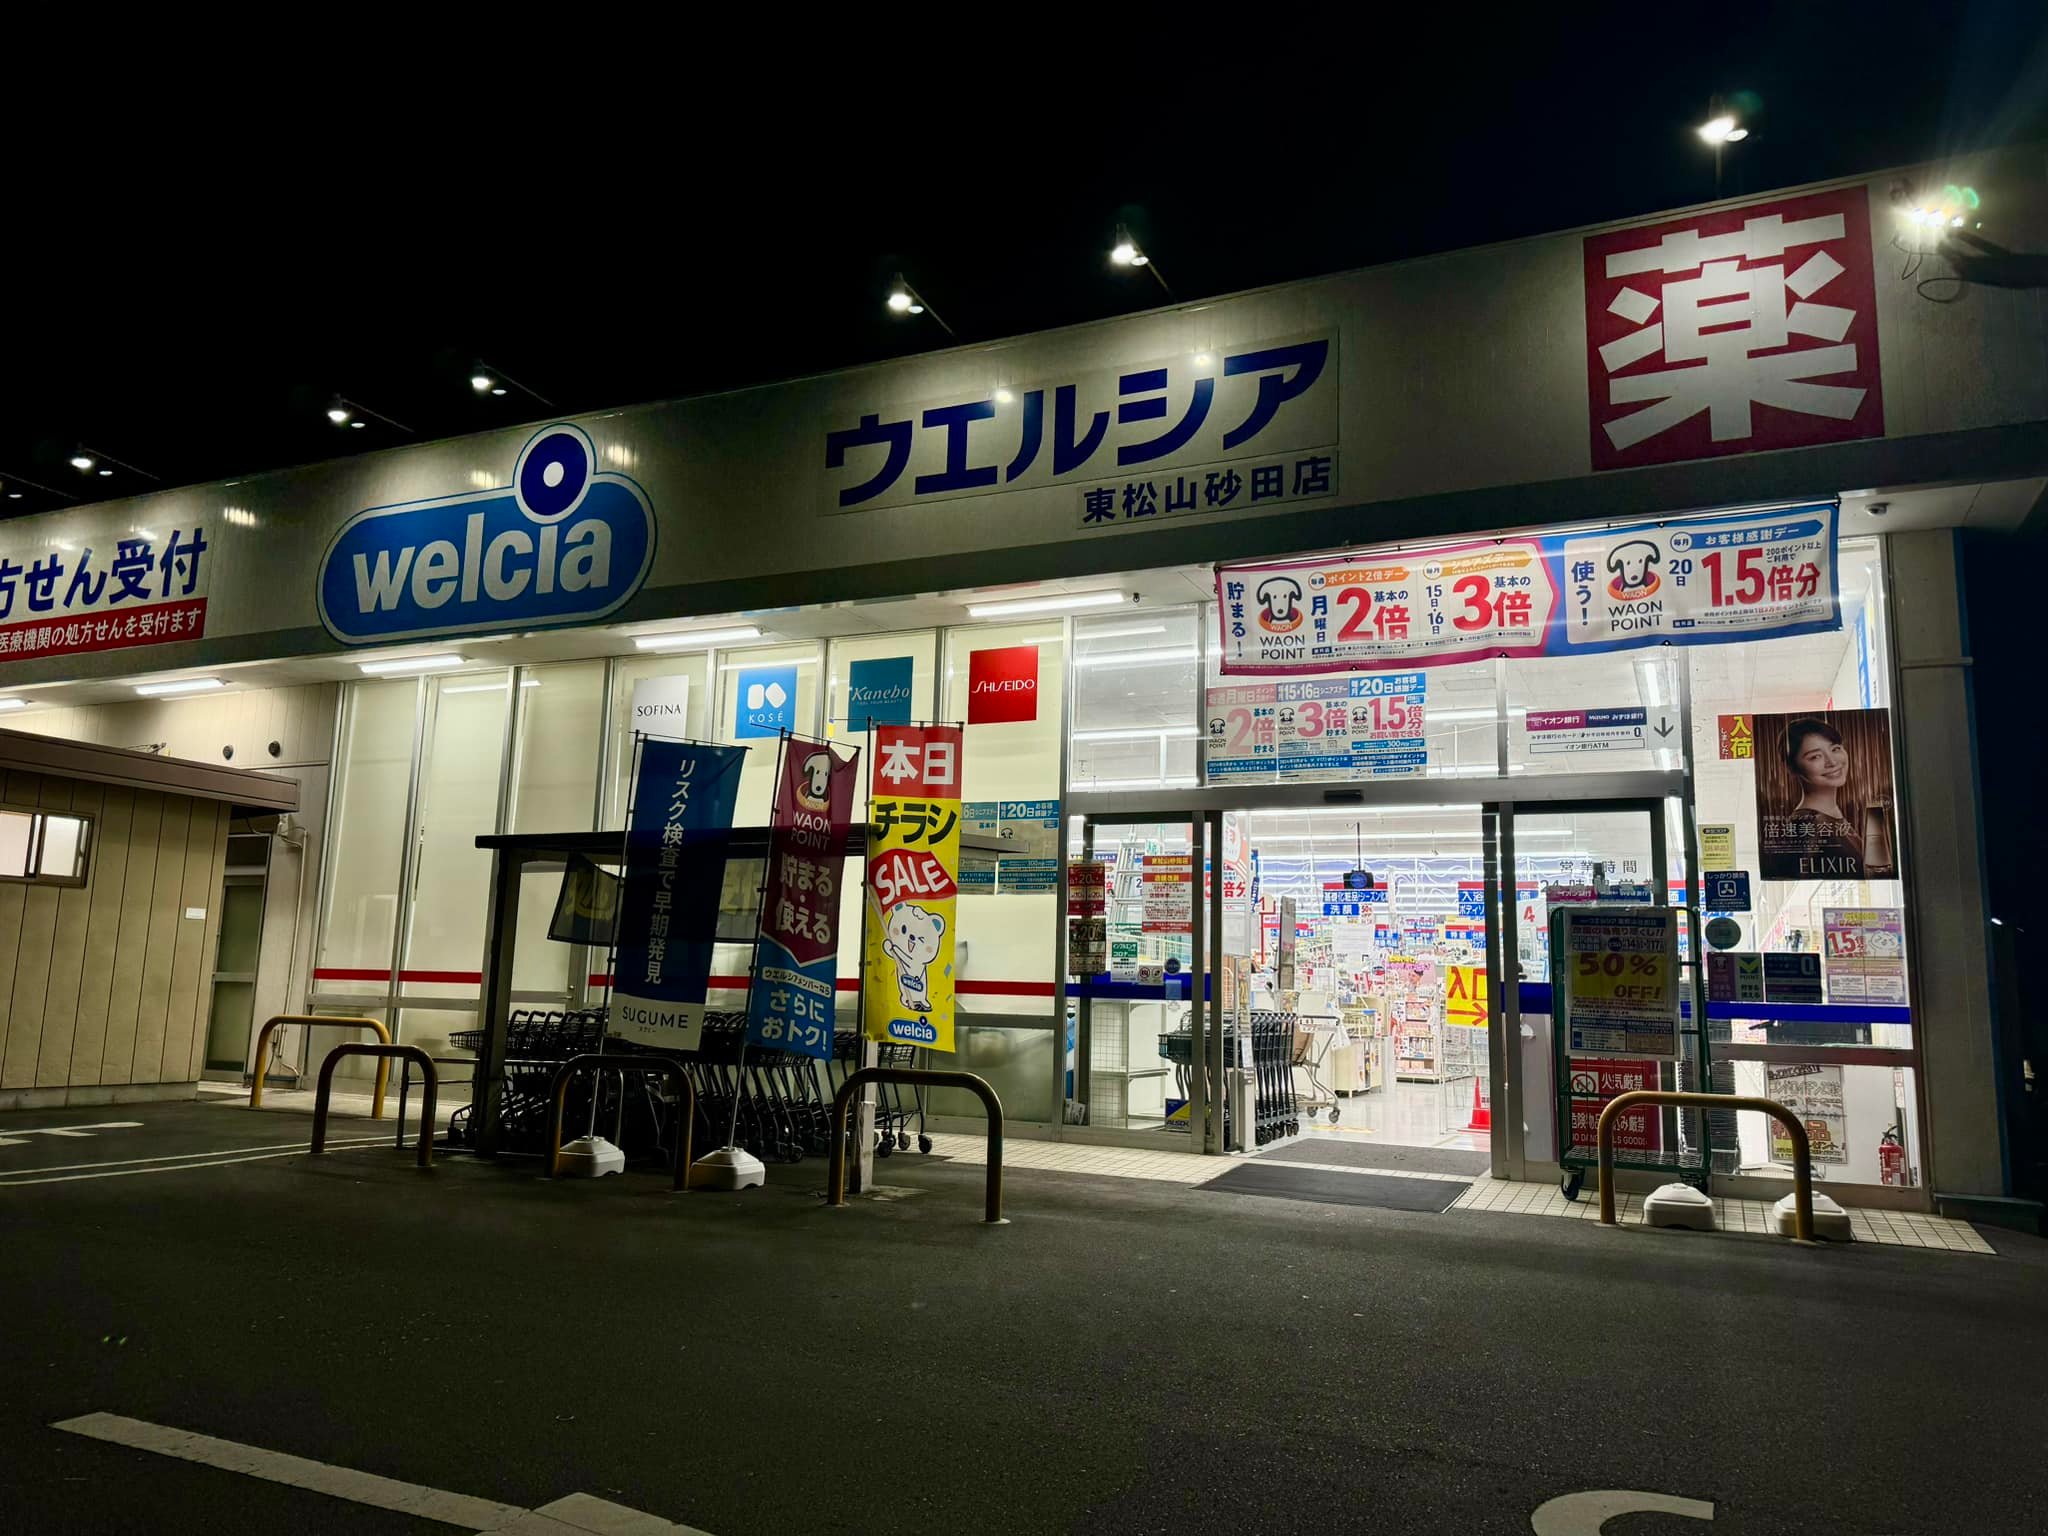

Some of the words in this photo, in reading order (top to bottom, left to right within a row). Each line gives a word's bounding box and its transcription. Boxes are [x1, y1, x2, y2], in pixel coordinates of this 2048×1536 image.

[1598, 213, 1867, 450] 薬
[825, 340, 1328, 507] ウエルシア
[1083, 456, 1332, 523] 東松山砂田店
[1705, 527, 1800, 545] お客様感謝デー
[353, 512, 612, 613] welcia
[1328, 571, 1404, 584] ポイント2倍デー
[1494, 575, 1531, 588] 基本の
[1701, 548, 1821, 608] 1.5倍分
[1374, 590, 1409, 602] 基本の
[1452, 575, 1532, 631] 3倍
[1311, 595, 1328, 643] 月曜日
[1336, 587, 1410, 642] 2倍
[1608, 600, 1662, 617] WAON
[1611, 614, 1662, 631] POINT
[1259, 635, 1305, 647] WAON
[1260, 648, 1306, 660] POINT
[851, 684, 911, 703] Kanebo
[971, 679, 1035, 693] SHISEIDO
[636, 703, 682, 718] SOFINA
[749, 711, 785, 725] KOSÉ
[1298, 701, 1347, 737] 3倍
[1542, 715, 1580, 725] イオン銀行
[1227, 708, 1275, 755] 2倍
[1730, 716, 1753, 759] 入荷
[880, 740, 955, 785] 本日
[793, 809, 832, 834] WAON
[875, 802, 958, 846] チラシ
[1763, 822, 1853, 838] 倍速美容液
[791, 827, 831, 850] POINT
[643, 758, 697, 985] リスク検査で早期発見
[1799, 857, 1857, 874] ELIXIR
[875, 854, 950, 905] SALE
[1579, 952, 1659, 977] 50%
[1614, 985, 1662, 999] OFF!
[622, 1006, 689, 1029] SUGUME
[769, 988, 825, 1024] さらに
[892, 1022, 934, 1040] welcia
